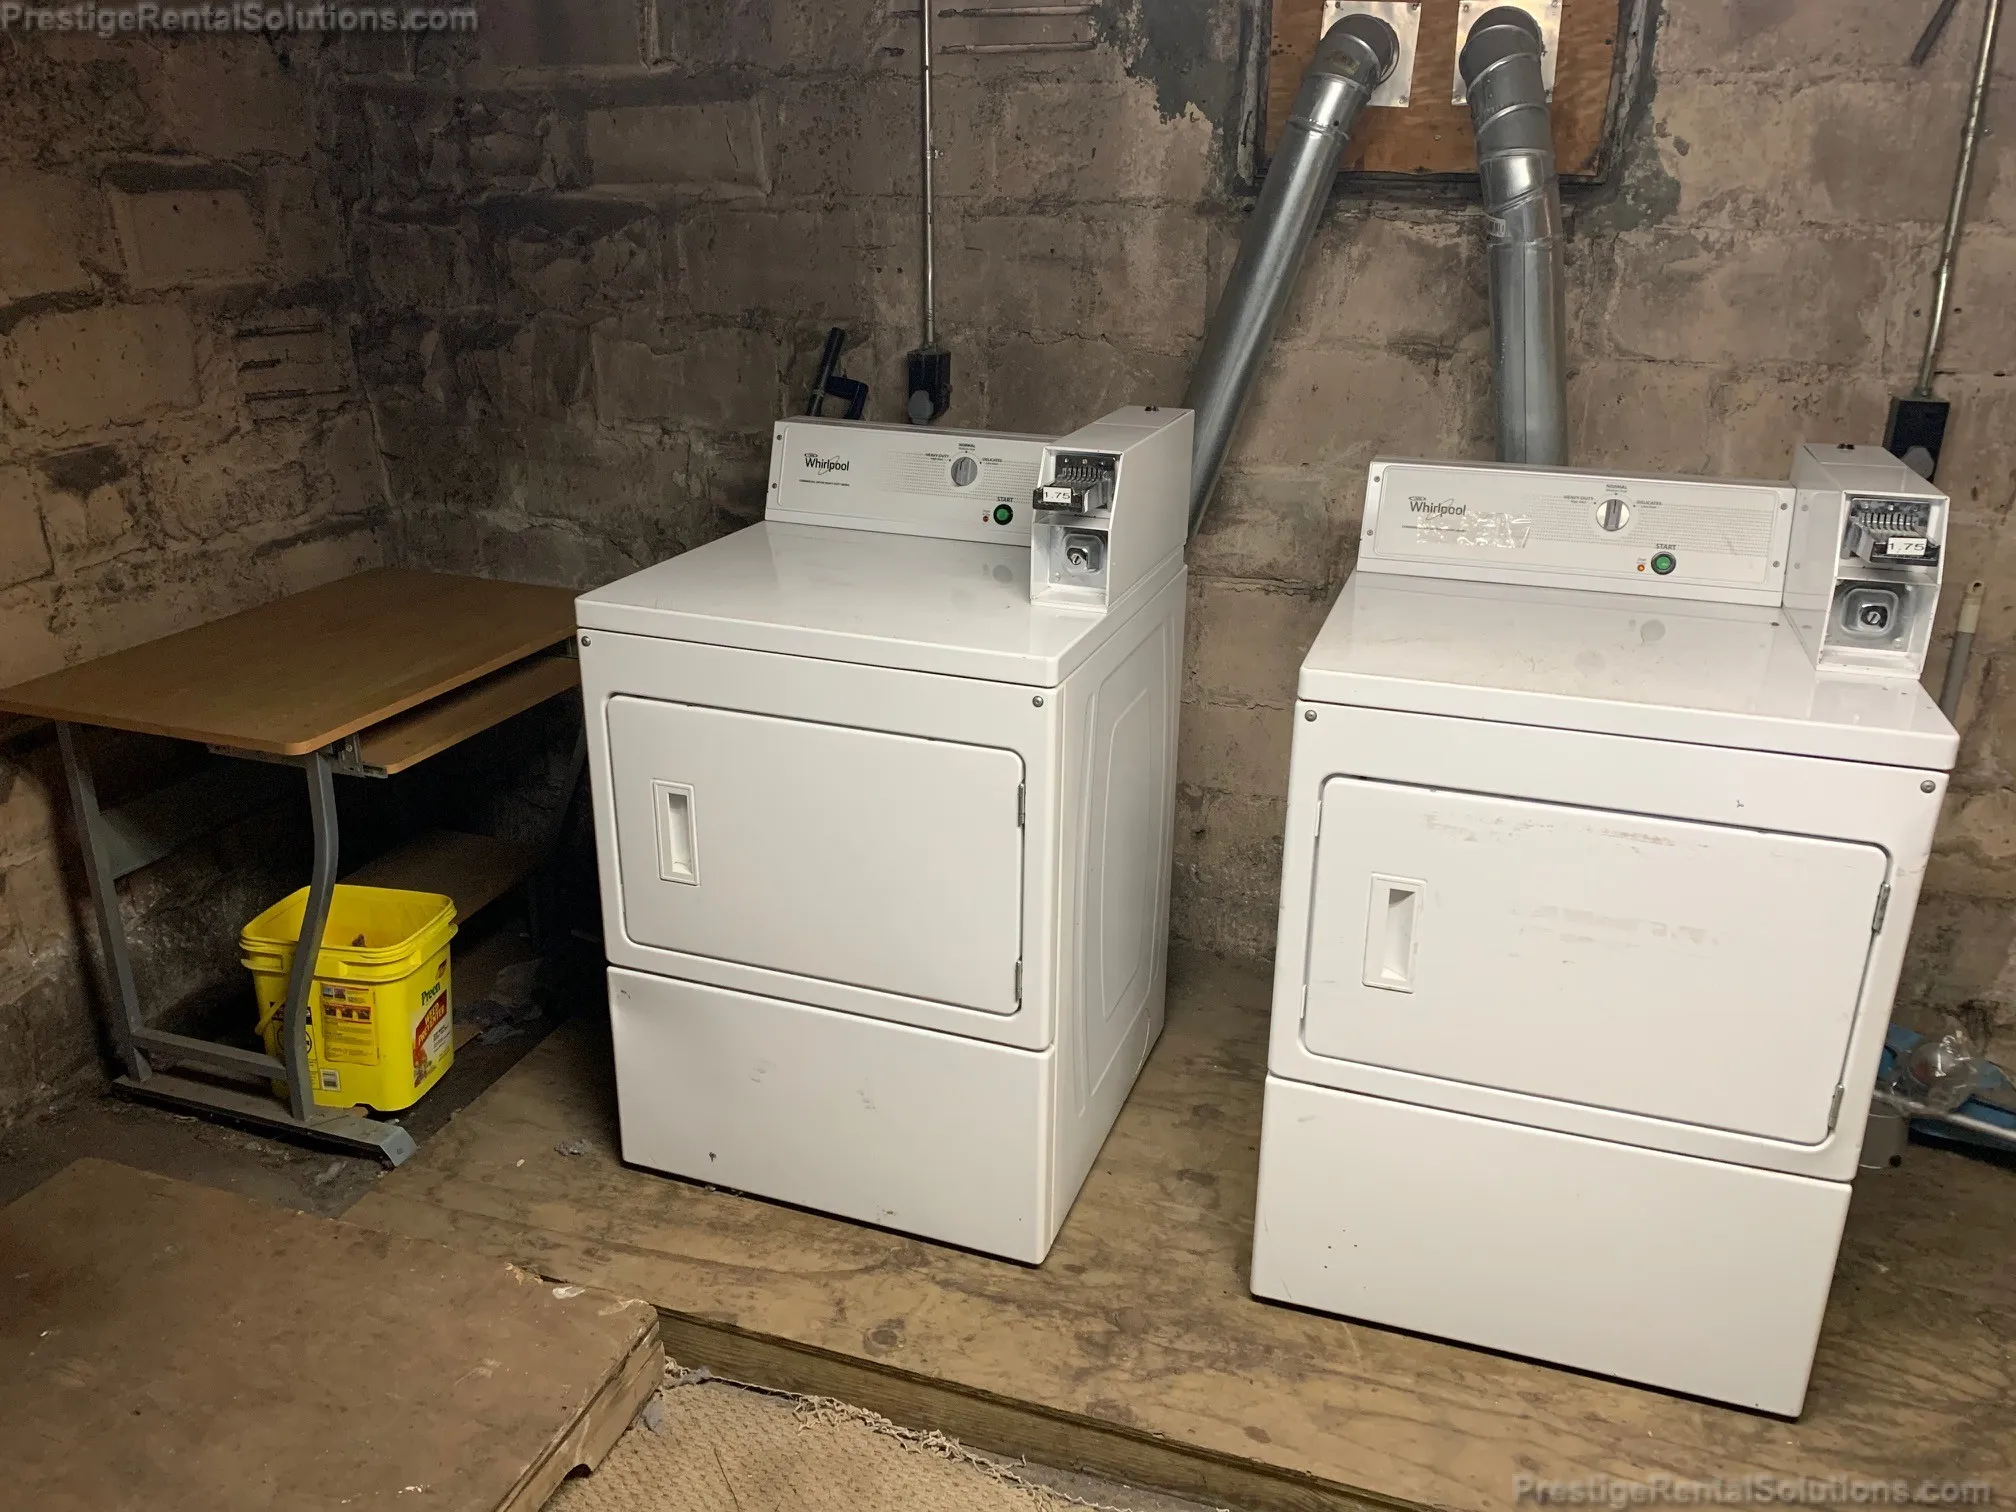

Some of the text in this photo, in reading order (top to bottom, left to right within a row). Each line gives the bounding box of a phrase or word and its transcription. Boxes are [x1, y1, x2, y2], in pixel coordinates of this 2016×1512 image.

[805, 457, 850, 472] Whirlpool
[1045, 491, 1070, 500] 1.75
[1409, 501, 1467, 517] Whirlpool
[1656, 543, 1677, 551] START
[1888, 542, 1925, 552] 1.75
